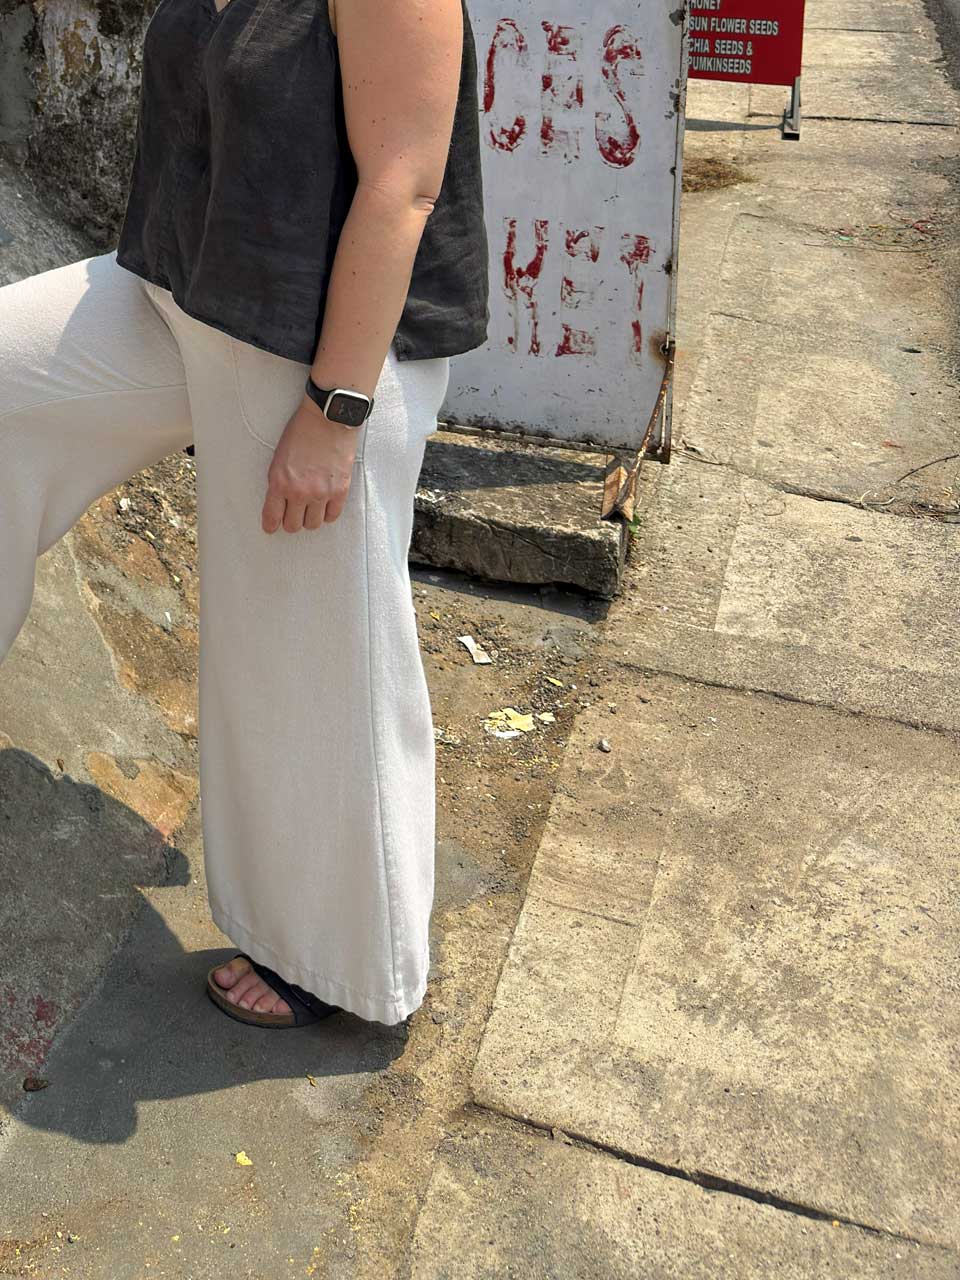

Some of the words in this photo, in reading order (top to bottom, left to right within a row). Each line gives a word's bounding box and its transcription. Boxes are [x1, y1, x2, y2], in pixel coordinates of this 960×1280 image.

[688, 37, 710, 53] CHIA
[714, 39, 744, 55] SEEDS
[746, 41, 753, 56] &
[689, 16, 709, 31] SUN
[710, 17, 747, 34] FLOWER
[749, 19, 779, 36] SEEDS
[482, 17, 642, 170] CES
[503, 217, 652, 368] KET
